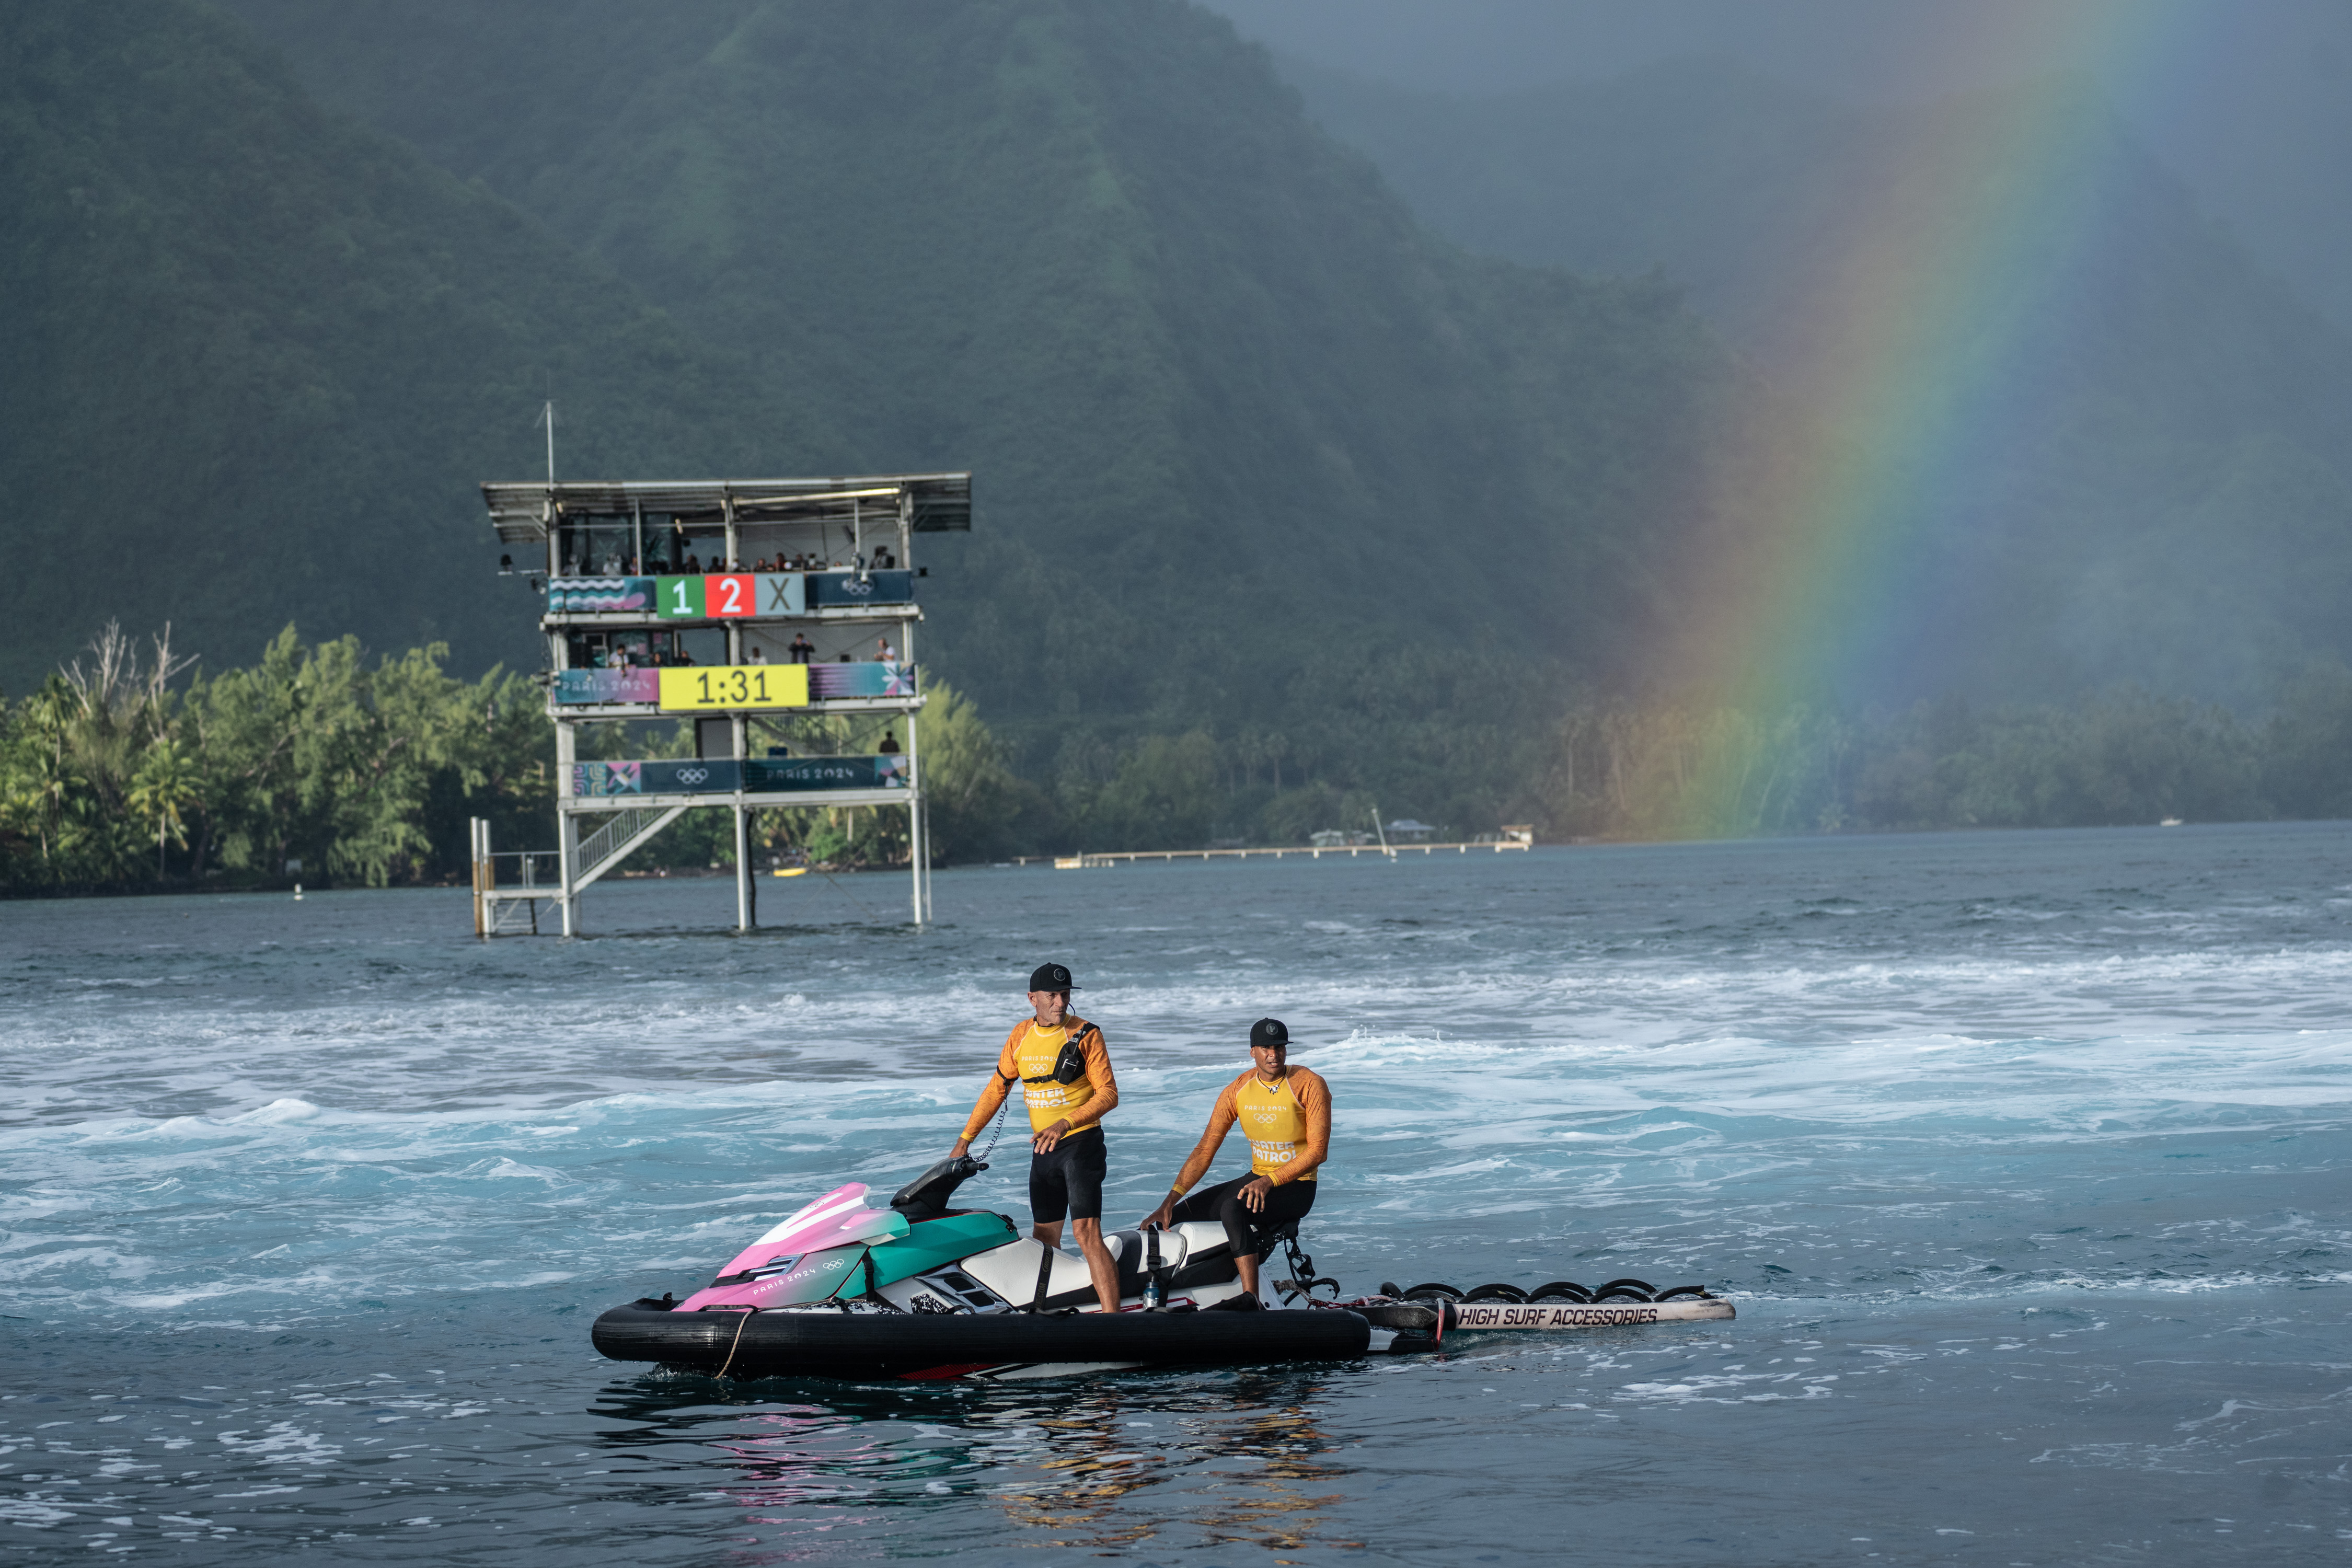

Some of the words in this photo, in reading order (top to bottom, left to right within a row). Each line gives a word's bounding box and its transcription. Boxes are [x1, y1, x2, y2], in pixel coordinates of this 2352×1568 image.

[672, 579, 693, 614] 1
[720, 577, 742, 613] 2
[768, 577, 791, 610] X
[562, 681, 605, 691] PARIS
[610, 680, 651, 691] 2024
[697, 669, 772, 704] 1:31
[766, 769, 810, 780] PARIS
[814, 767, 854, 779] 2024
[1025, 1088, 1065, 1098] WATER
[1024, 1097, 1070, 1109] PATROL
[1248, 1138, 1295, 1150] WATER
[753, 1279, 784, 1295] PARIS
[787, 1269, 816, 1282] 2024
[1458, 1309, 1500, 1325] HIGH
[1503, 1309, 1547, 1325] SURF
[1549, 1308, 1657, 1325] ACCESSORIES
